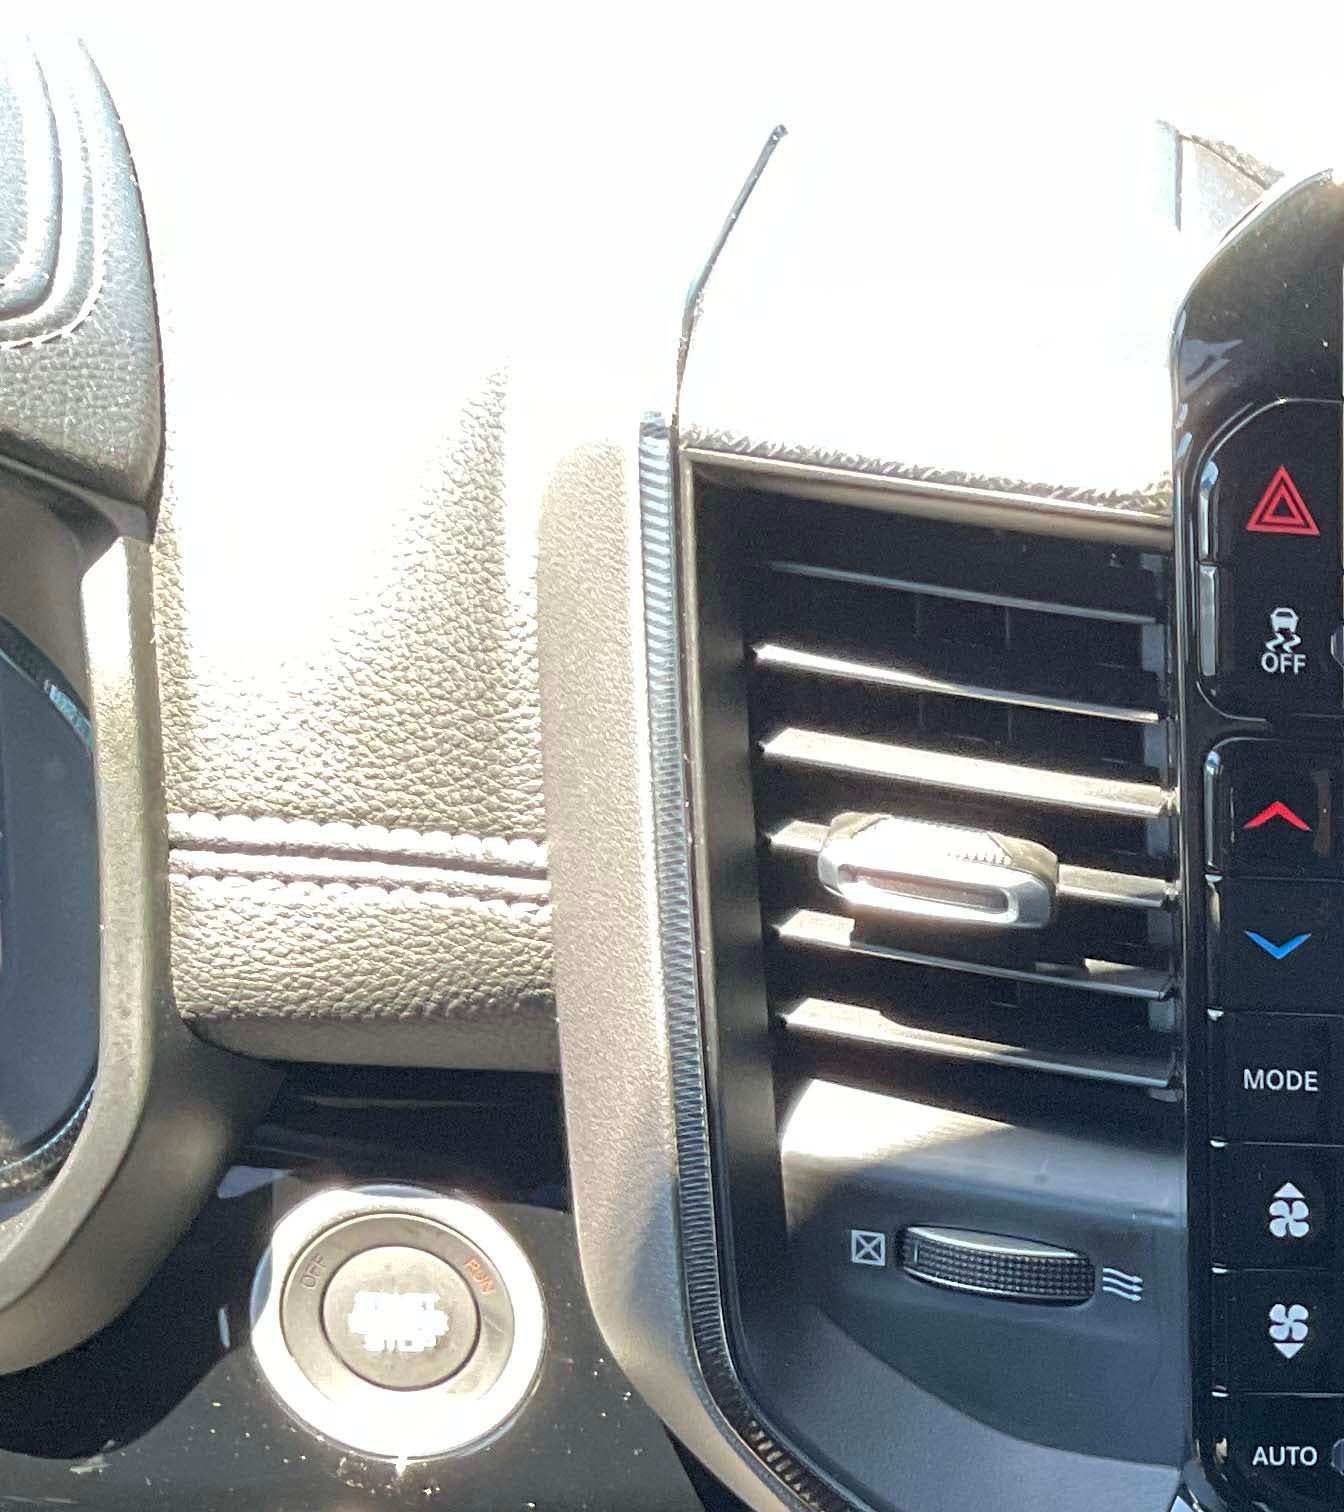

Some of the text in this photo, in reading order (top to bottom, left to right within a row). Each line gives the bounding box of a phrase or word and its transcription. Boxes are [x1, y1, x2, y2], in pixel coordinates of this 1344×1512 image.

[1261, 653, 1306, 673] OFF
[1243, 1069, 1318, 1092] MODE
[464, 1255, 495, 1296] RUN
[1252, 1446, 1318, 1466] AUTO
